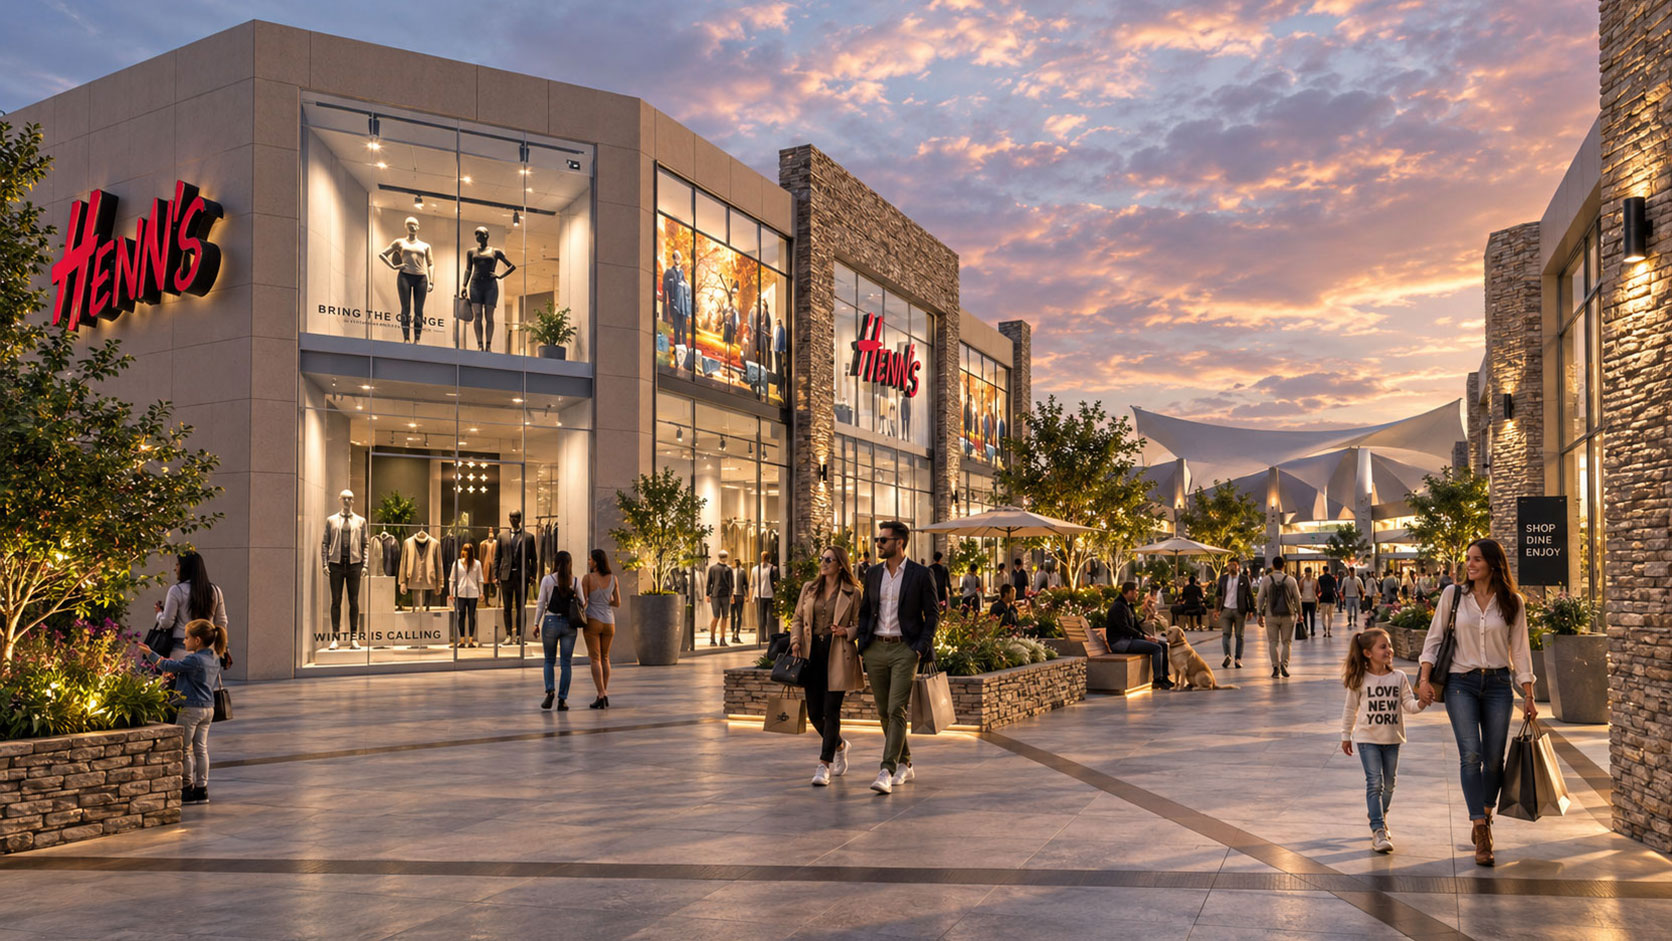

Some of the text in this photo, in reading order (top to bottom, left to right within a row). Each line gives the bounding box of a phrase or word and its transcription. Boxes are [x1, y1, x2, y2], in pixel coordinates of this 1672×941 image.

[52, 180, 206, 331] HENN'S
[318, 304, 361, 318] BRING
[366, 310, 392, 322] THE
[395, 313, 445, 327] CNGE
[856, 311, 922, 398] HENN'S
[1526, 523, 1556, 533] SHOP
[1526, 535, 1552, 545] DINE
[1526, 547, 1561, 557] ENJOY
[313, 630, 441, 642] WINTER IS CALLING
[1367, 685, 1399, 698] LOVE
[1368, 700, 1398, 712] NEW
[1366, 713, 1399, 725] YORK
